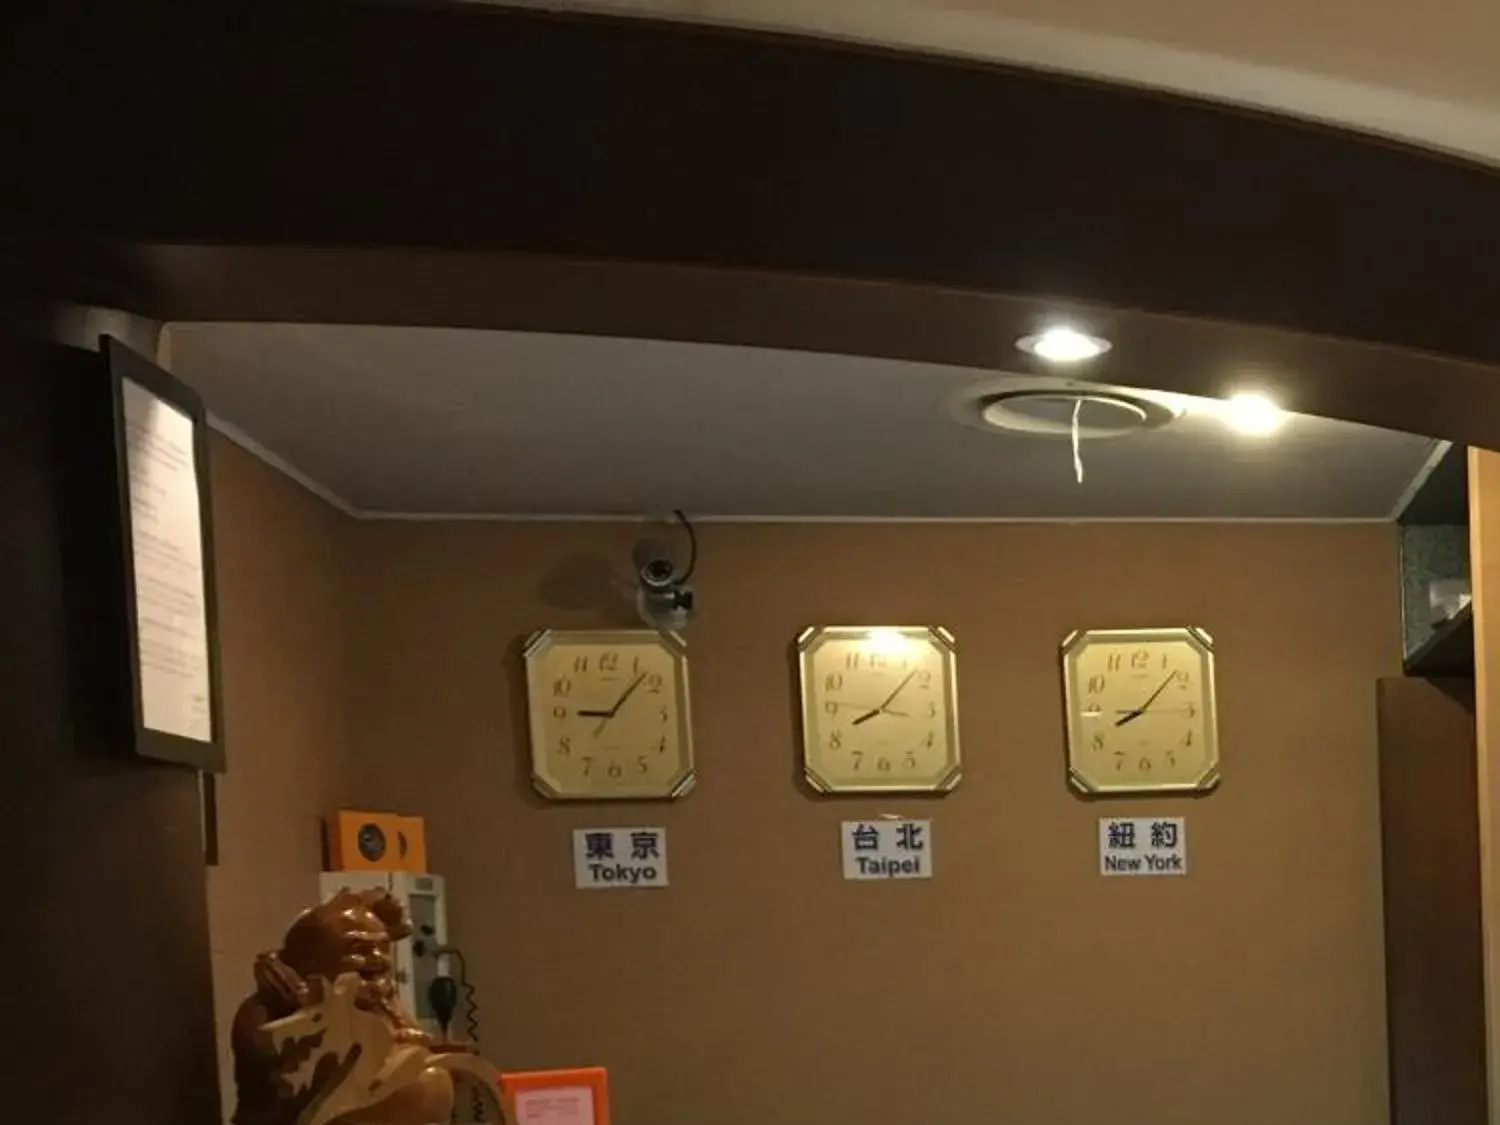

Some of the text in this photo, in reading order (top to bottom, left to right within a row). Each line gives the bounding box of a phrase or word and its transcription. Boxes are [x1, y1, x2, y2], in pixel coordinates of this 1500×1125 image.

[574, 656, 588, 674] 11
[599, 653, 618, 671] 12
[846, 653, 858, 669] 11
[1107, 652, 1120, 671] 11
[1131, 651, 1149, 669] 12
[553, 676, 572, 696] 10
[648, 674, 662, 693] 2
[825, 673, 843, 692] 10
[919, 671, 932, 690] 2
[1087, 675, 1105, 694] 10
[1176, 671, 1190, 690] 2
[553, 706, 566, 721] 9
[660, 706, 668, 723] 3
[825, 702, 838, 719] 9
[927, 702, 936, 720] 3
[1187, 704, 1196, 718] 3
[558, 737, 571, 756] 8
[652, 736, 667, 753] 4
[829, 729, 842, 750] 8
[922, 730, 934, 749] 4
[1092, 732, 1104, 752] 8
[1183, 729, 1193, 747] 4
[581, 757, 594, 777] 7
[608, 760, 621, 778] 6
[637, 756, 648, 774] 5
[852, 751, 864, 771] 7
[877, 754, 891, 772] 6
[904, 751, 916, 770] 5
[1114, 752, 1125, 771] 7
[1138, 755, 1152, 772] 6
[1166, 751, 1177, 768] 5
[852, 823, 923, 850] 台北
[1108, 821, 1178, 849] 紐約
[585, 831, 659, 859] 東京
[855, 856, 920, 876] Taipei
[1104, 853, 1183, 872] New York
[589, 863, 657, 884] Tokyo
